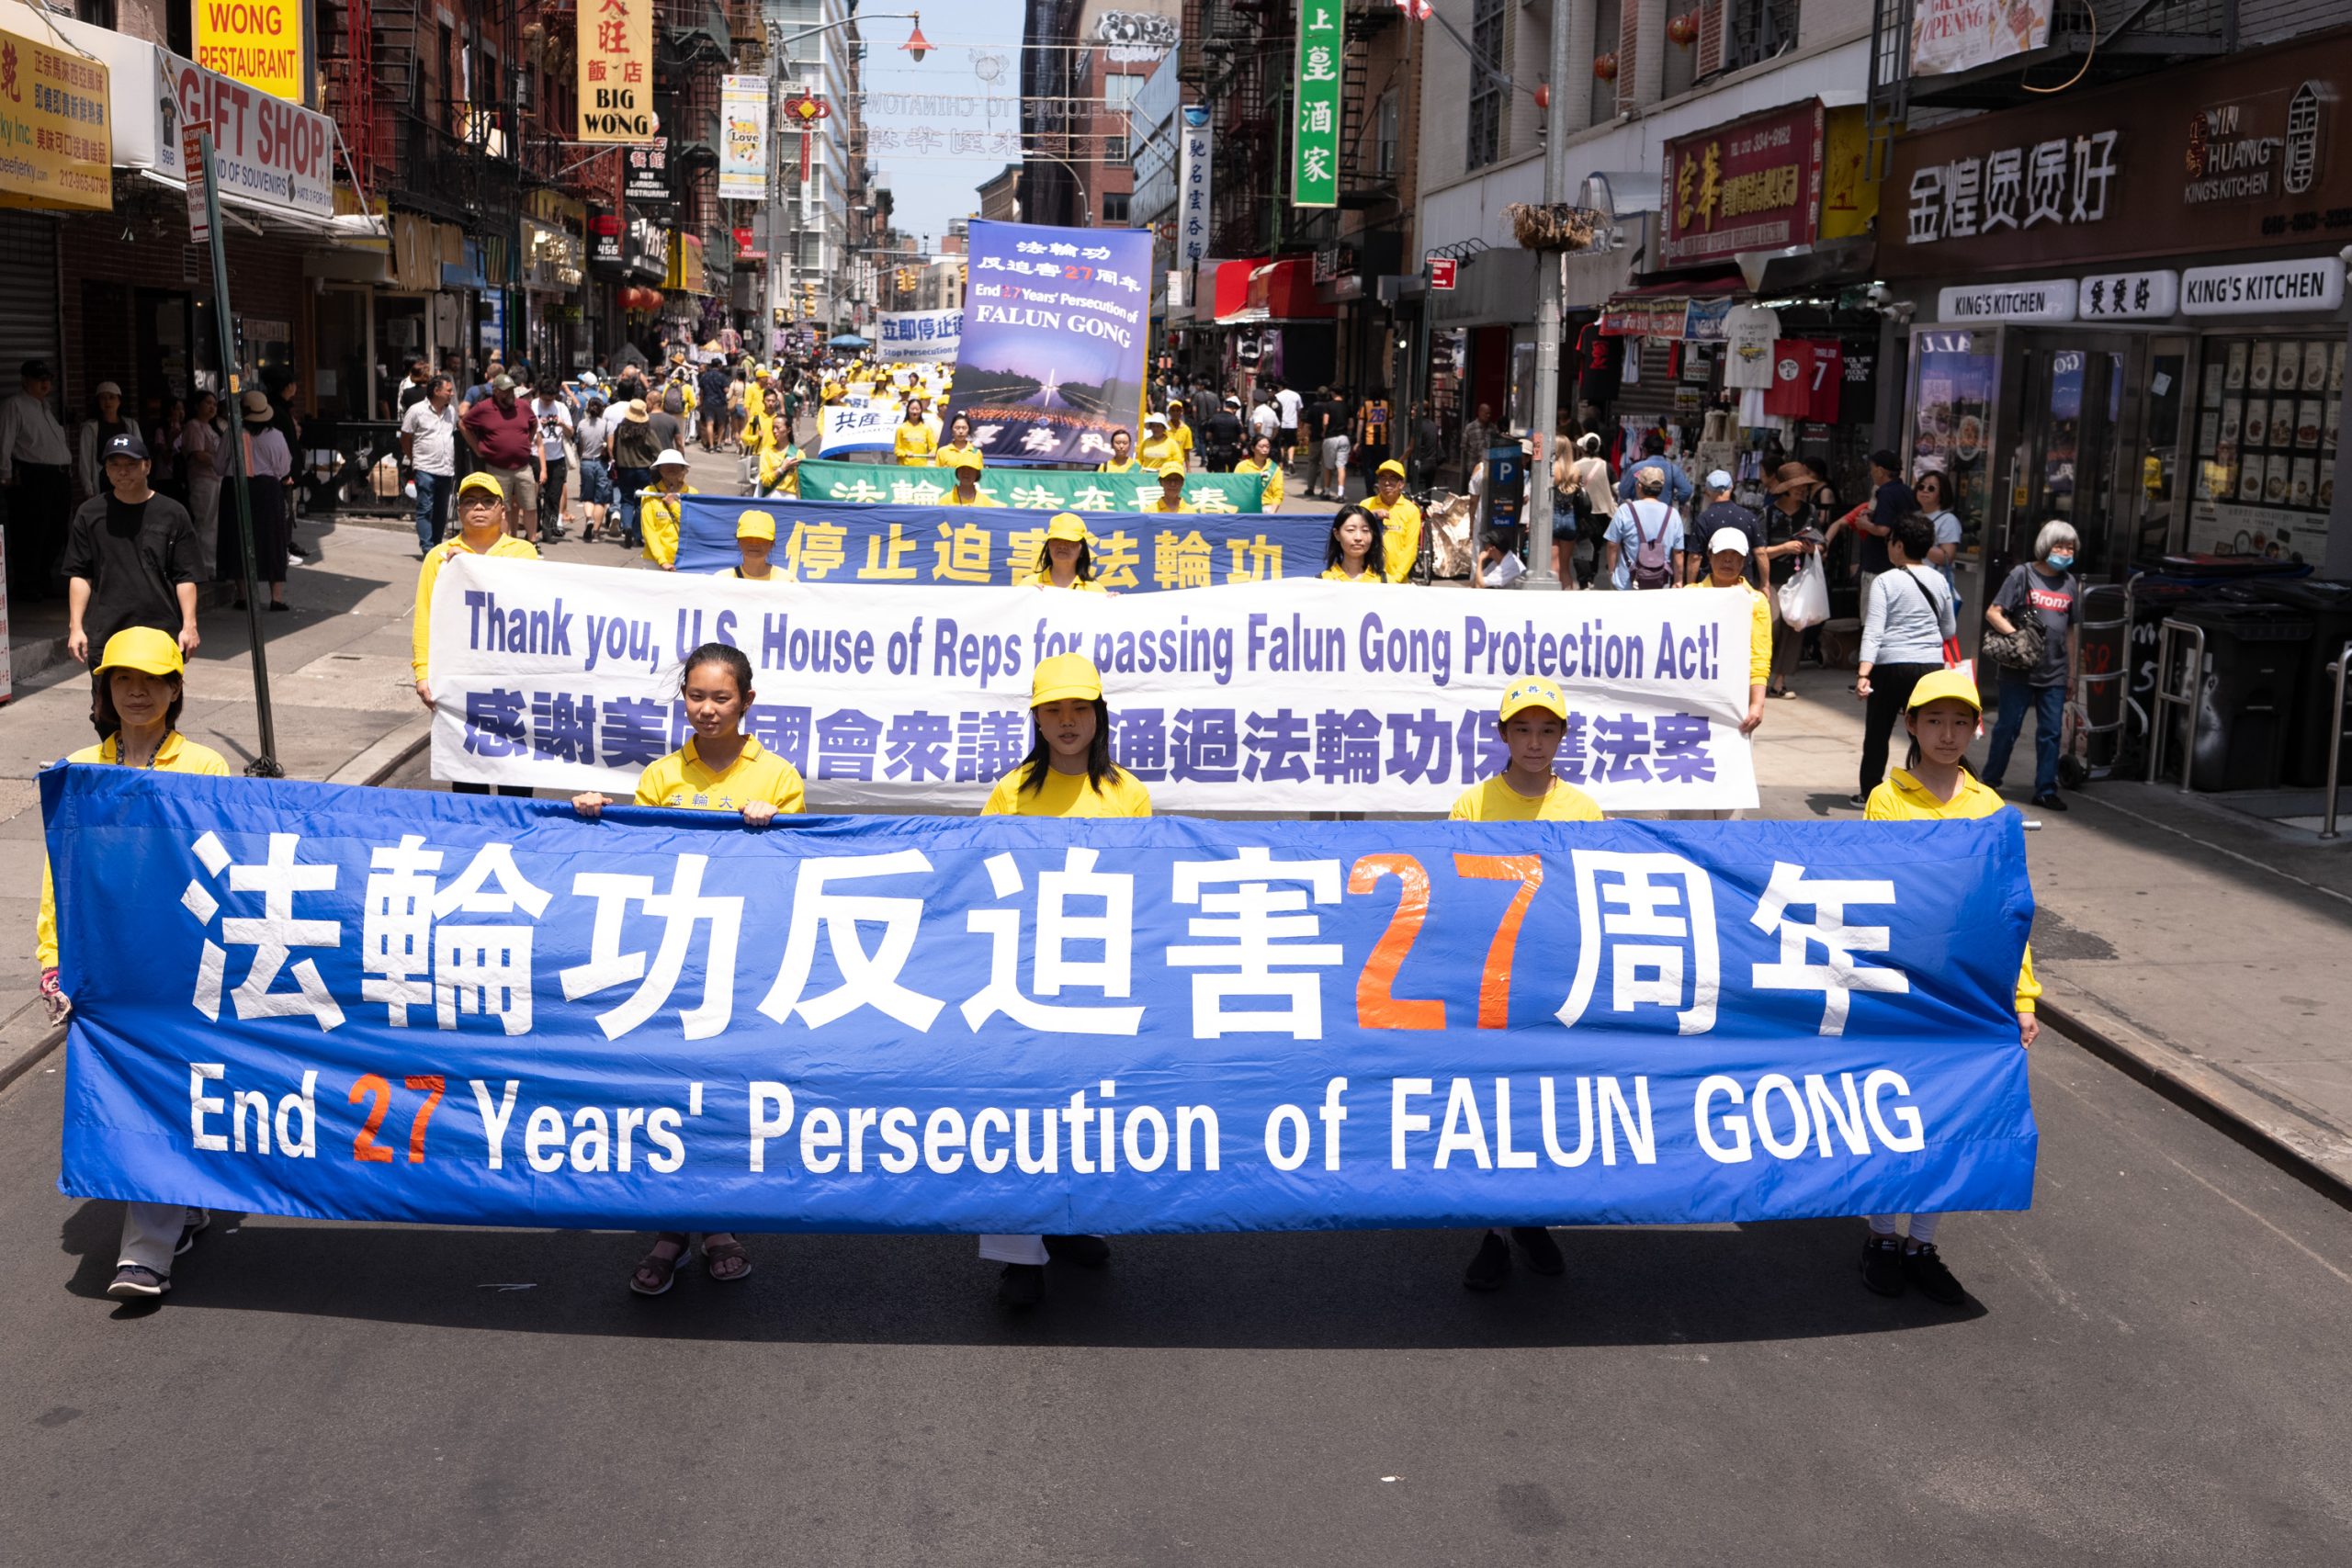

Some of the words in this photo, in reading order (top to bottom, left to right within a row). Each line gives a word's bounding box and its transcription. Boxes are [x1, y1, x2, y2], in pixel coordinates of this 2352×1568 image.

[209, 4, 283, 35] WONG
[199, 45, 296, 80] RESTAURANT
[588, 59, 642, 83] 飯店
[596, 88, 635, 109] BIG
[16, 116, 34, 147] Inc.
[179, 68, 249, 157] GIFT
[257, 98, 324, 179] SHOP
[583, 114, 649, 136] WONG
[2211, 106, 2240, 136] JIN
[731, 131, 760, 142] Love
[2208, 138, 2271, 174] HUANG
[60, 169, 109, 196] 212-965-0796
[229, 164, 241, 183] OF
[242, 167, 288, 197] SOUVENIRS
[639, 171, 655, 180] NEW
[2185, 177, 2219, 204] KING'S
[2220, 170, 2270, 199] KITCHEN
[626, 189, 671, 198] RESTAURANT
[597, 244, 619, 255] 456
[1016, 241, 1112, 261] 法輪功
[978, 256, 1142, 293] 反迫害27周年
[2187, 276, 2242, 304] KING'S
[2246, 271, 2325, 299] KITCHEN
[975, 283, 1001, 298] End
[1001, 284, 1022, 299] 27
[1022, 288, 1059, 305] Years'
[1060, 292, 1127, 320] Persecution
[1127, 310, 1139, 324] of
[1955, 294, 1992, 316] KING'S
[1995, 291, 2046, 314] KITCHEN
[975, 304, 1062, 331] FALUN
[1068, 314, 1132, 349] GONG
[883, 348, 902, 357] Stop
[903, 344, 954, 356] Persecution
[1843, 356, 1858, 365] UCK
[1812, 361, 1827, 391] 7
[1499, 461, 1513, 481] P
[831, 479, 1238, 513] 法輪法在長春
[786, 520, 1283, 589] 停止迫害法輪功
[2030, 590, 2073, 609] Bronx
[465, 591, 572, 656] Thank
[585, 614, 661, 673] you,
[675, 608, 738, 662] US
[761, 612, 875, 673] House
[888, 616, 923, 675] of
[934, 618, 1022, 689] Reps
[1034, 617, 1084, 660] for
[1093, 615, 1233, 685] passing
[1247, 613, 1345, 671] Falun
[1359, 612, 1451, 686] Gong
[1464, 616, 1644, 678] Protection
[1655, 621, 1718, 680] Act!
[671, 794, 751, 809] 法輪大
[180, 829, 1909, 1042] 法輪功反迫害27周年
[190, 1063, 319, 1158] End
[348, 1073, 446, 1164] 27
[469, 1079, 704, 1173] Years'
[749, 1079, 1220, 1175] Persecution
[1264, 1077, 1348, 1171] of
[1391, 1076, 1657, 1170] FALUN
[1694, 1069, 1925, 1164] GONG
